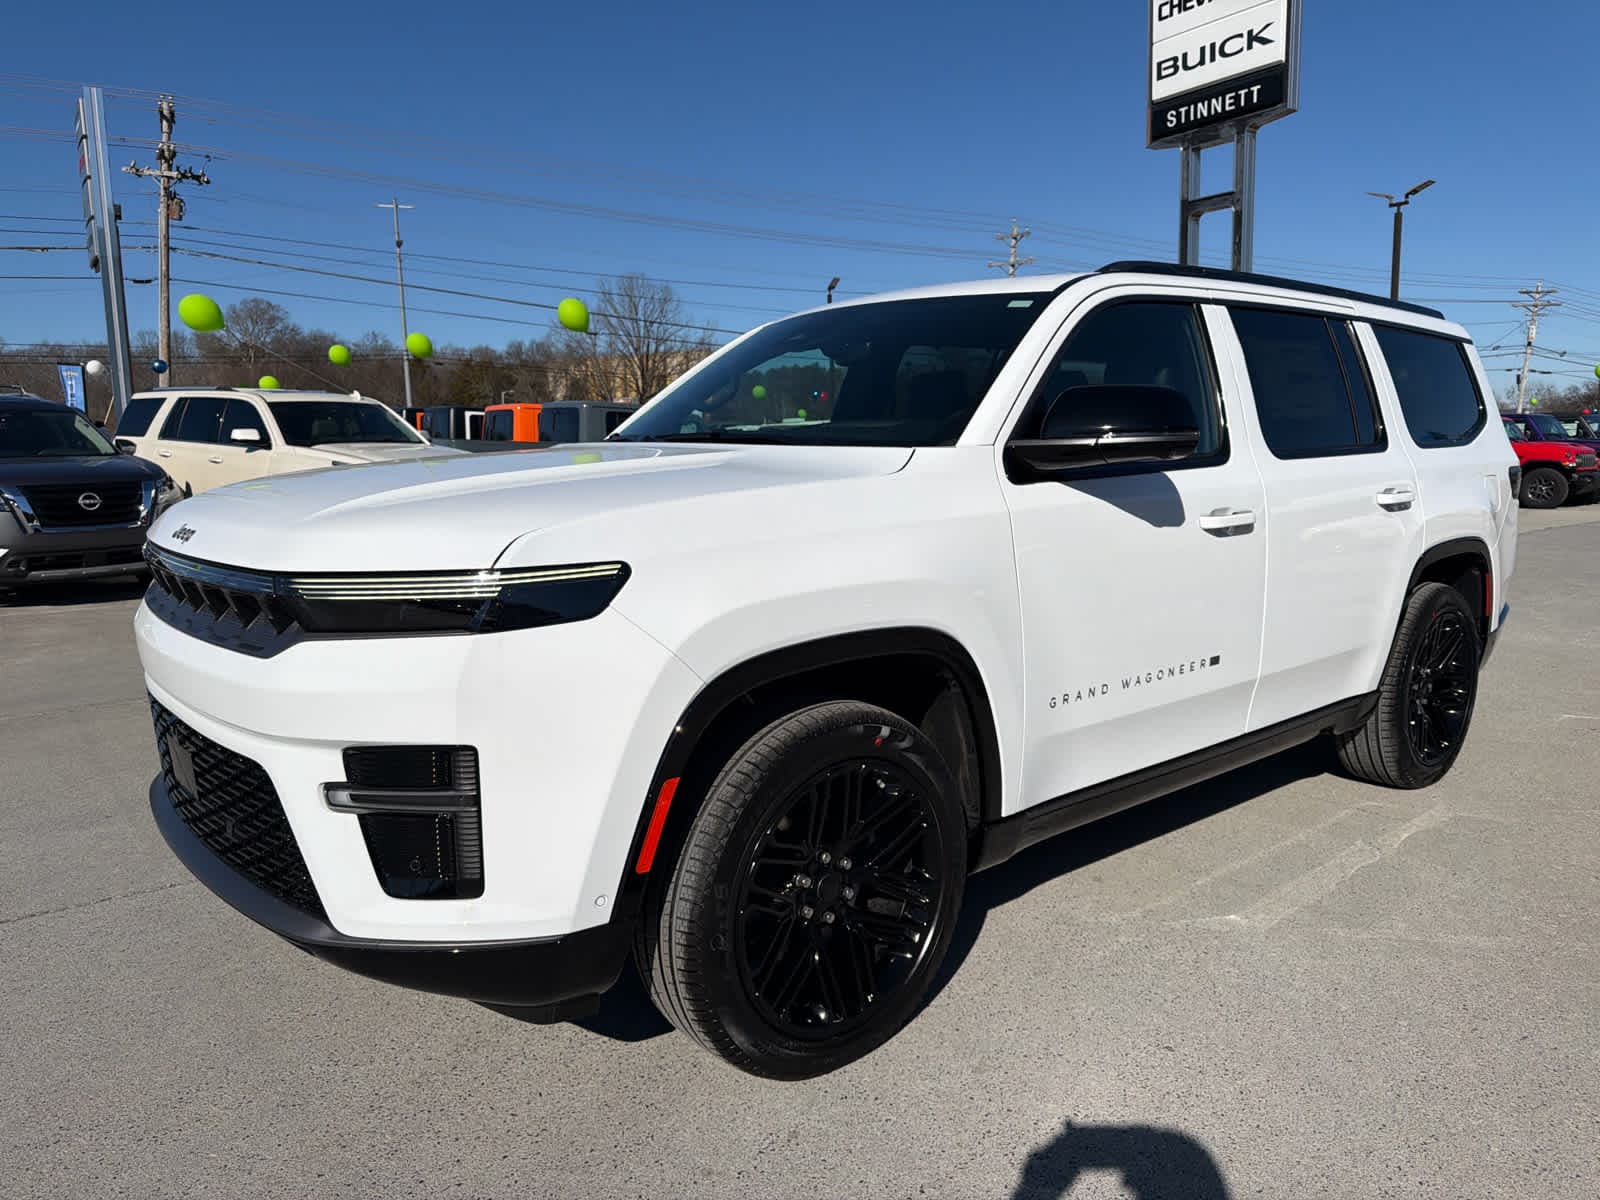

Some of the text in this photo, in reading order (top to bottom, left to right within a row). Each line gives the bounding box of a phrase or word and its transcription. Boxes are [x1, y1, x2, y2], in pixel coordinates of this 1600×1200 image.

[1156, 21, 1275, 82] BUICK
[1166, 84, 1262, 128] STINNETT
[1049, 658, 1207, 709] GRAND WAGONEER
